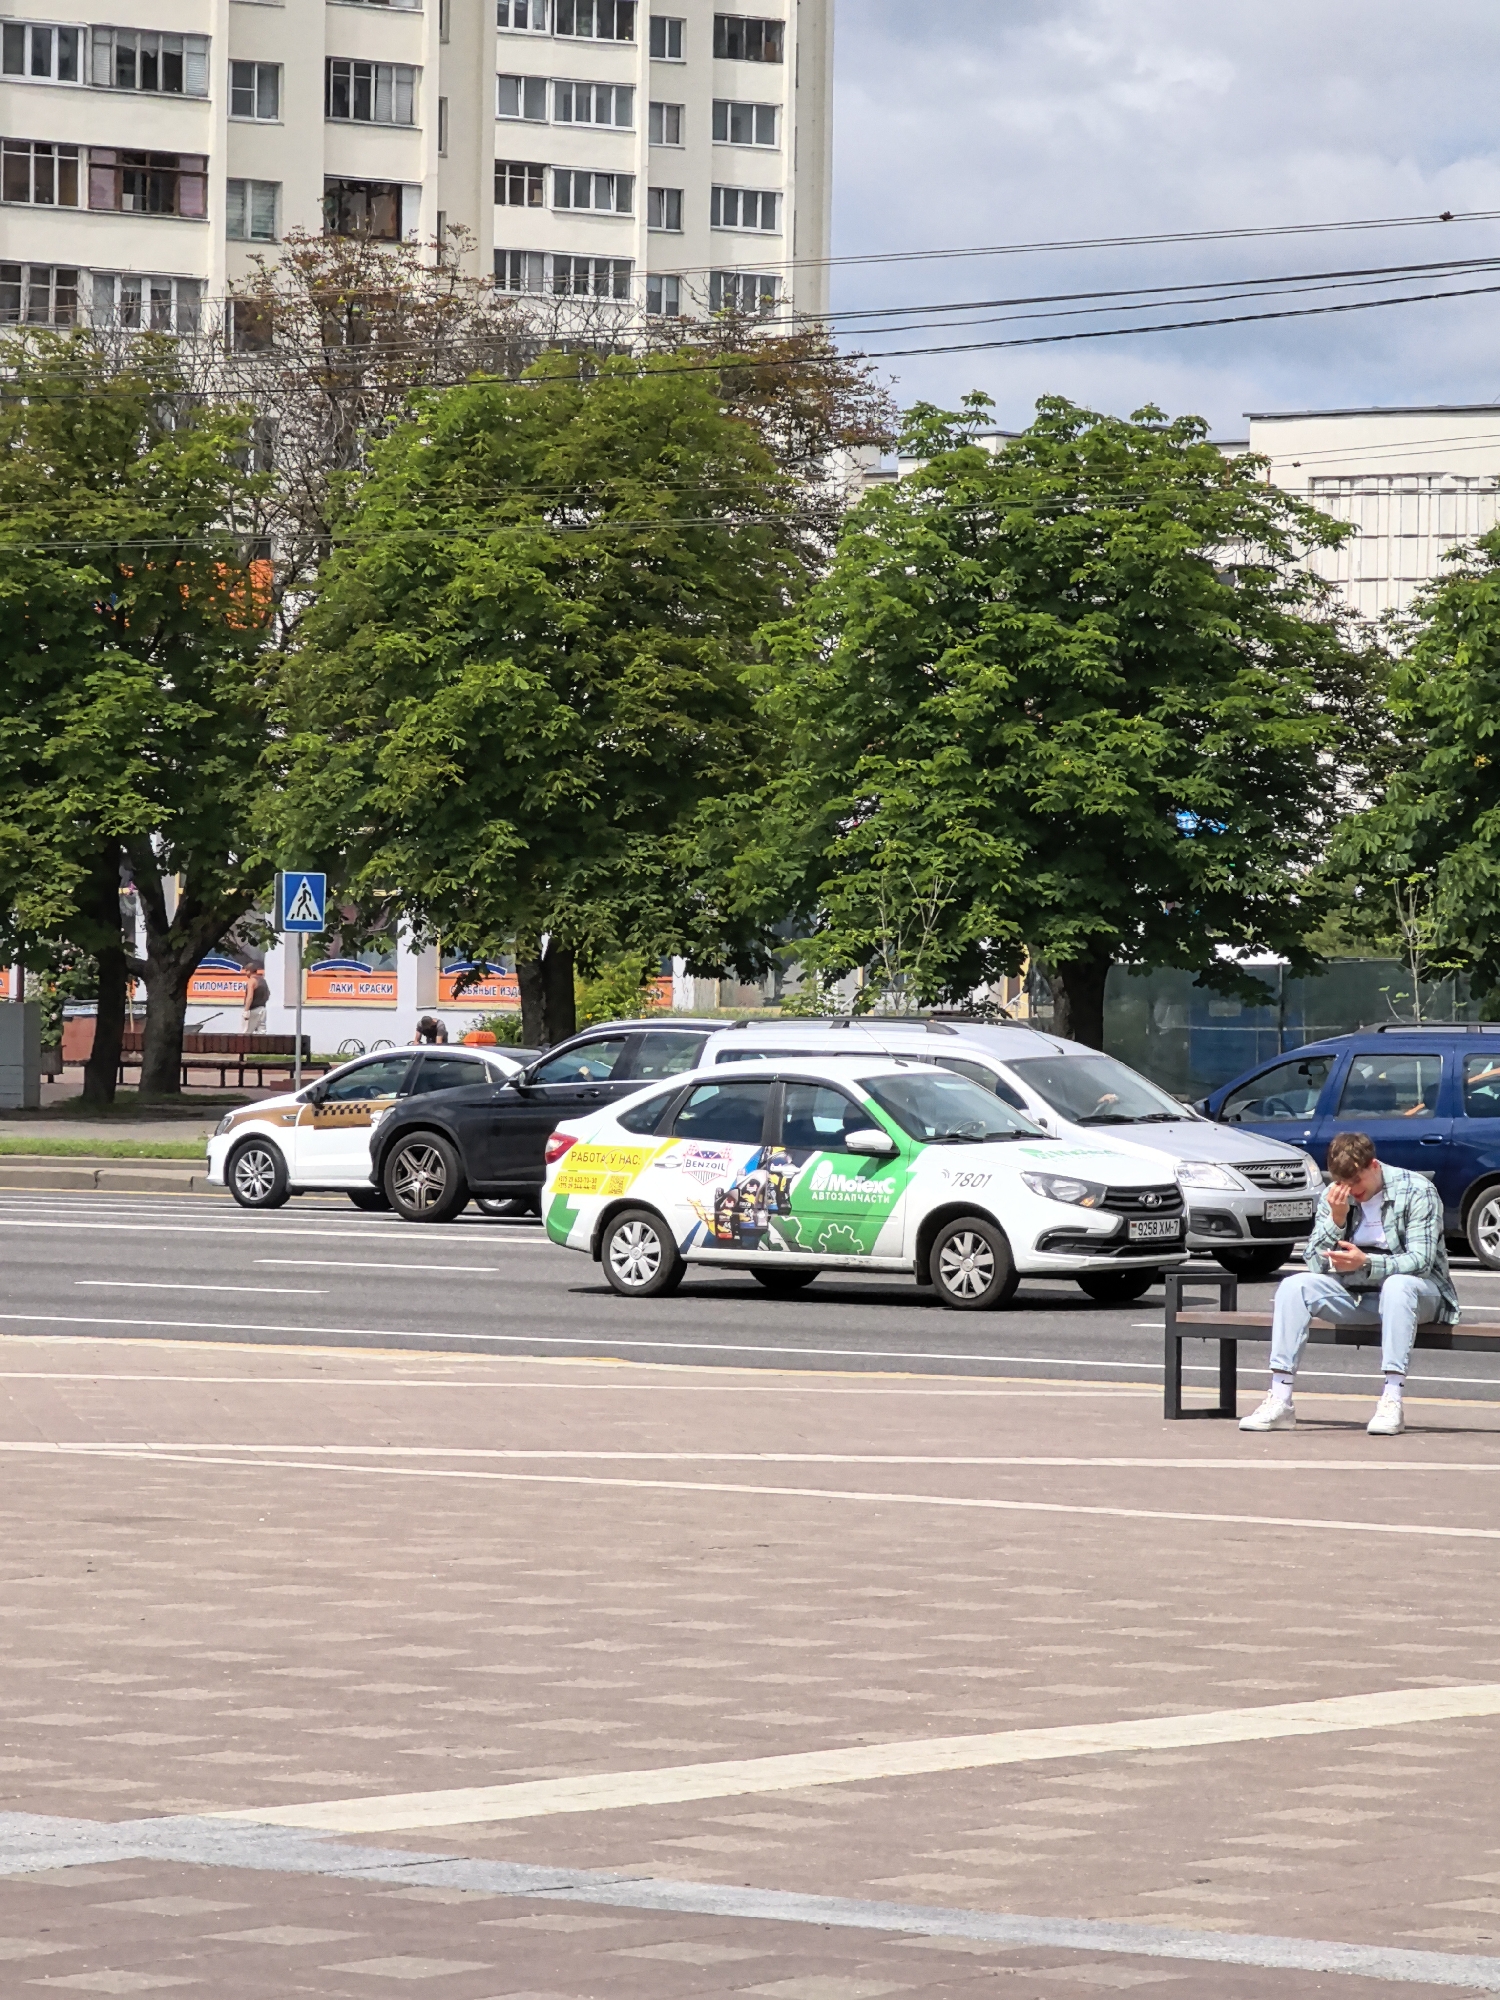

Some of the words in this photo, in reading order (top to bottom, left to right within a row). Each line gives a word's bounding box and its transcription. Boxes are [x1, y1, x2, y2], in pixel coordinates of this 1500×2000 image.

[329, 983, 355, 995] ЛАКИ,
[359, 983, 393, 994] КРАСКИ
[570, 1151, 606, 1163] РАБОТА
[610, 1153, 617, 1164] У
[618, 1154, 641, 1166] НАС:
[685, 1159, 725, 1172] BENZOIL
[951, 1172, 993, 1188] 7801
[811, 1192, 890, 1203] АВТОЗАПЧАСТИ
[1138, 1221, 1158, 1236] 9258
[1159, 1220, 1179, 1235] XM-7
